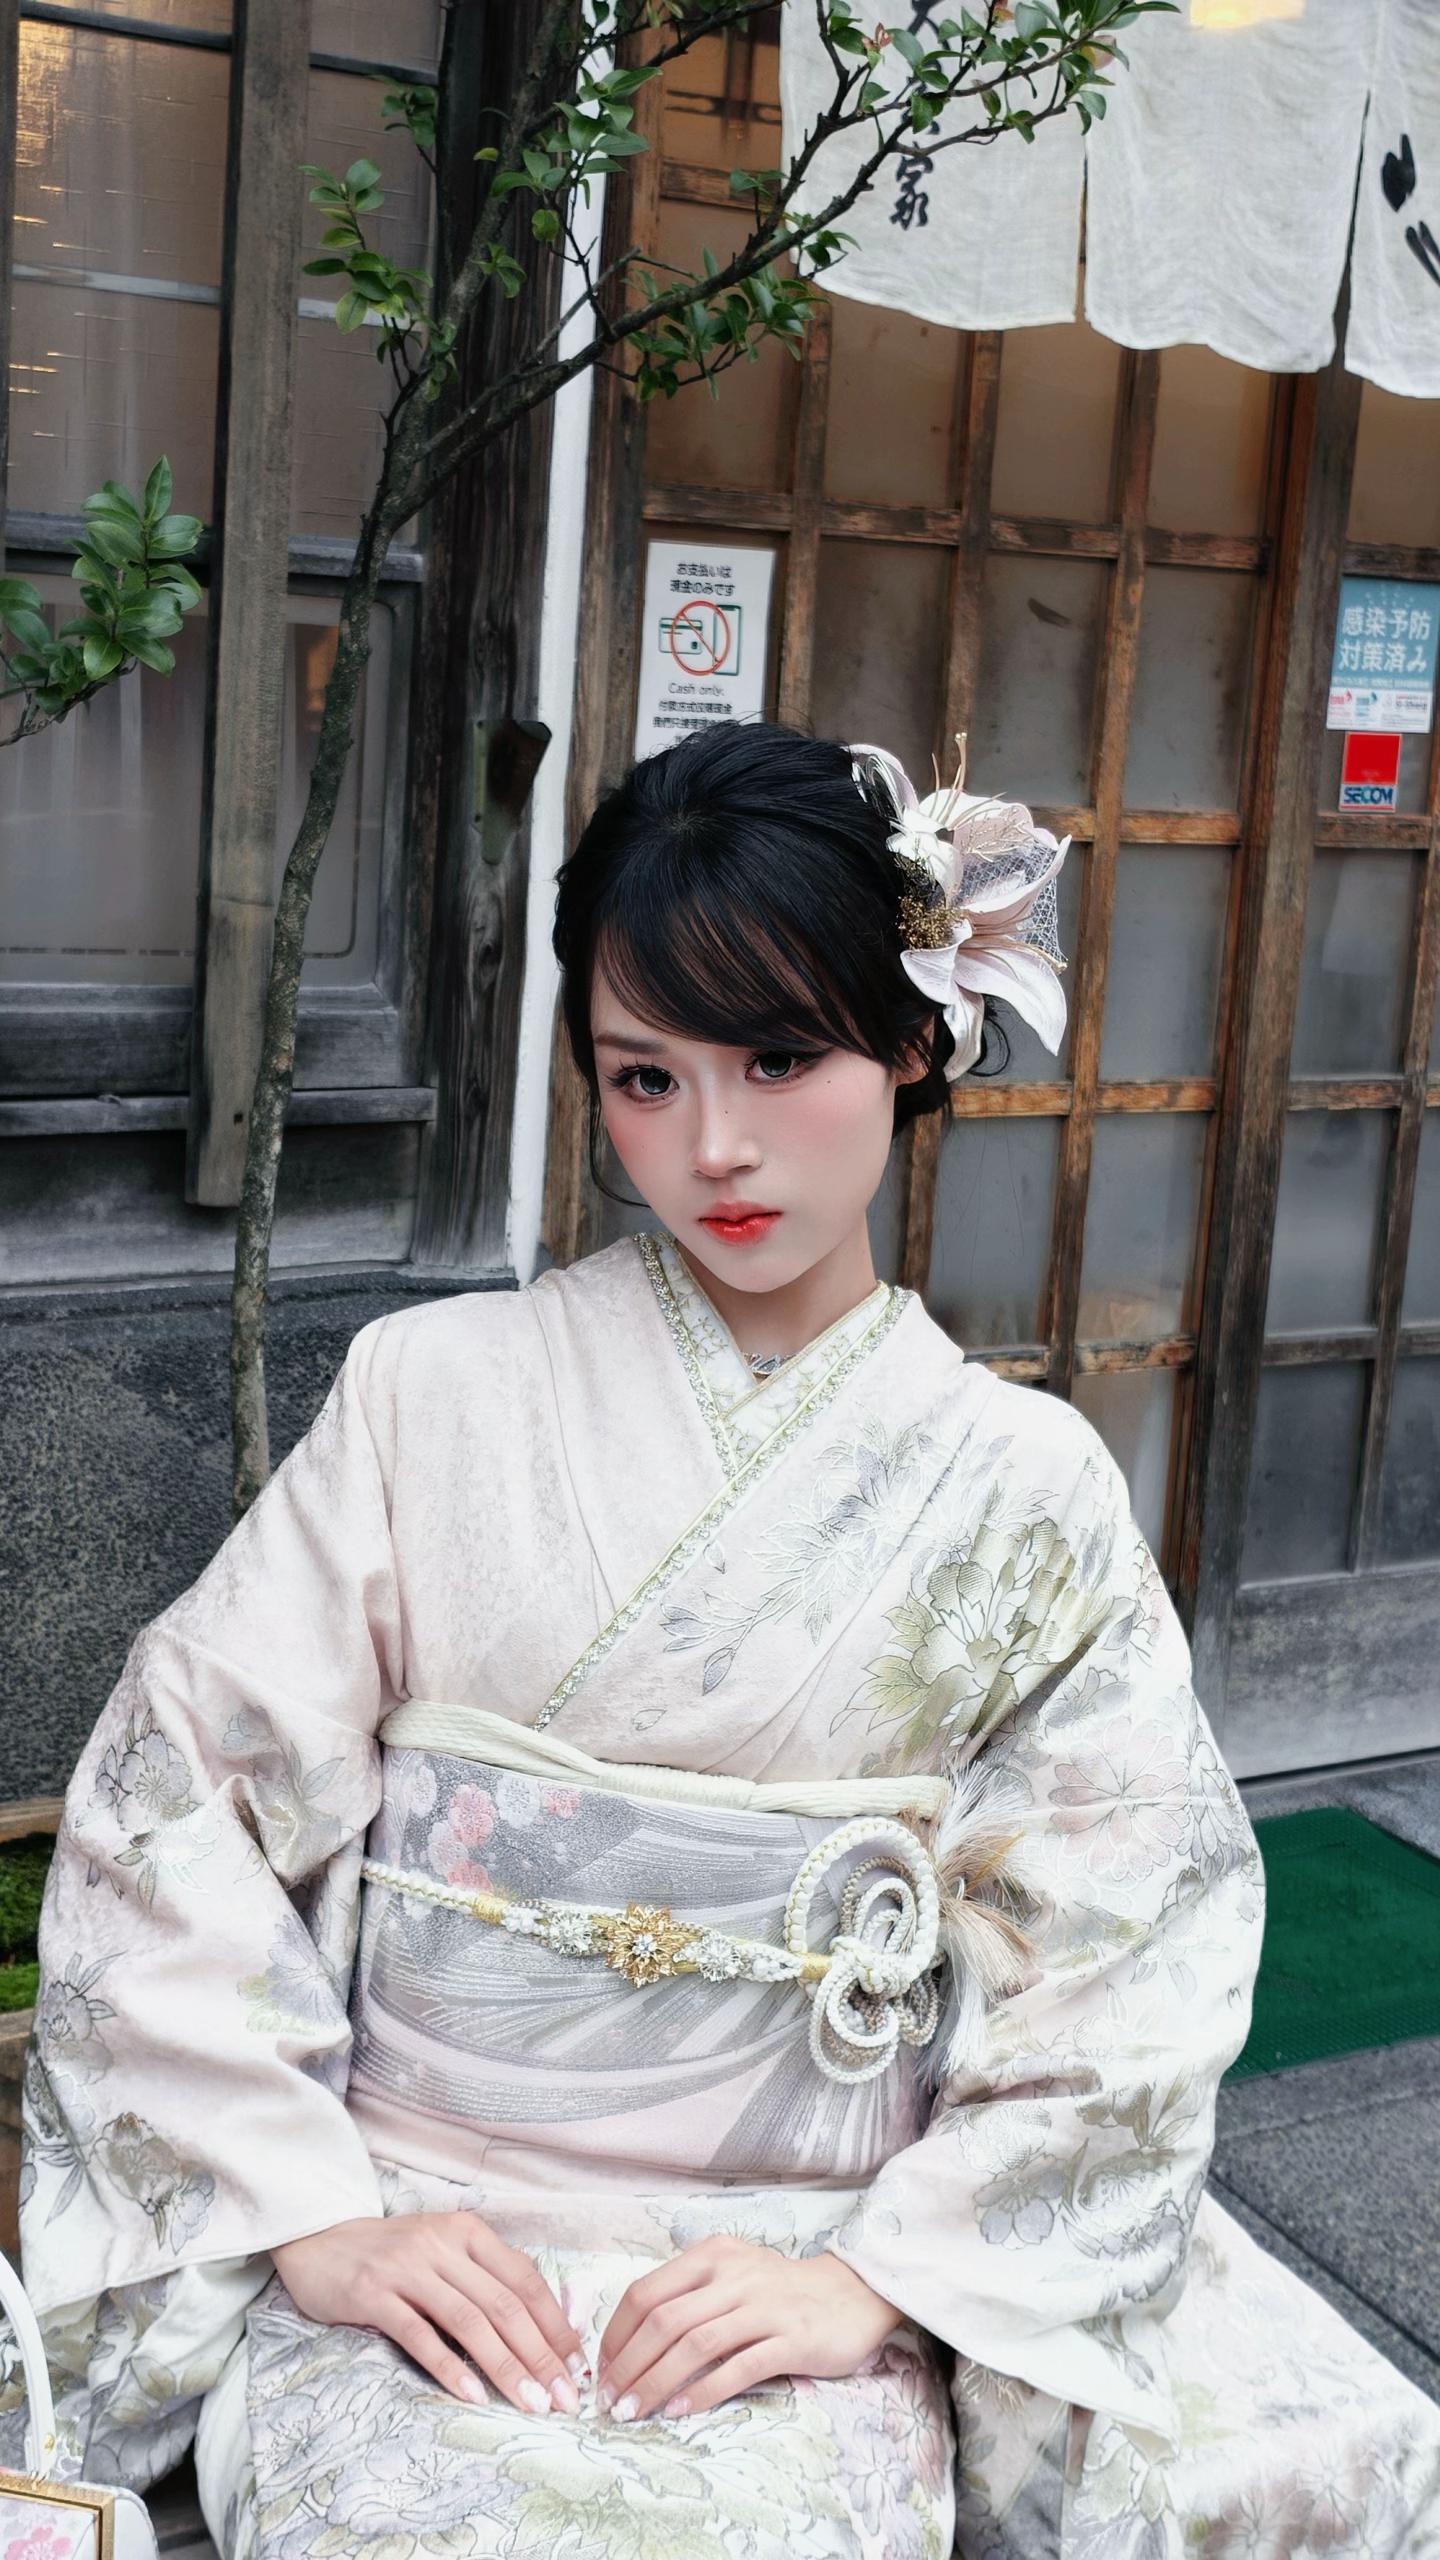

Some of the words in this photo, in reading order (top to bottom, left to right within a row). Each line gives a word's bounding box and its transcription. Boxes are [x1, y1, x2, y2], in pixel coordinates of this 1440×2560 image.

[676, 562, 732, 578] お支払いは
[670, 579, 735, 596] 現金のみです
[1341, 606, 1432, 641] 感染予防
[1338, 641, 1428, 673] 対策済み
[668, 682, 695, 695] Cash
[1344, 786, 1394, 804] SECOM
